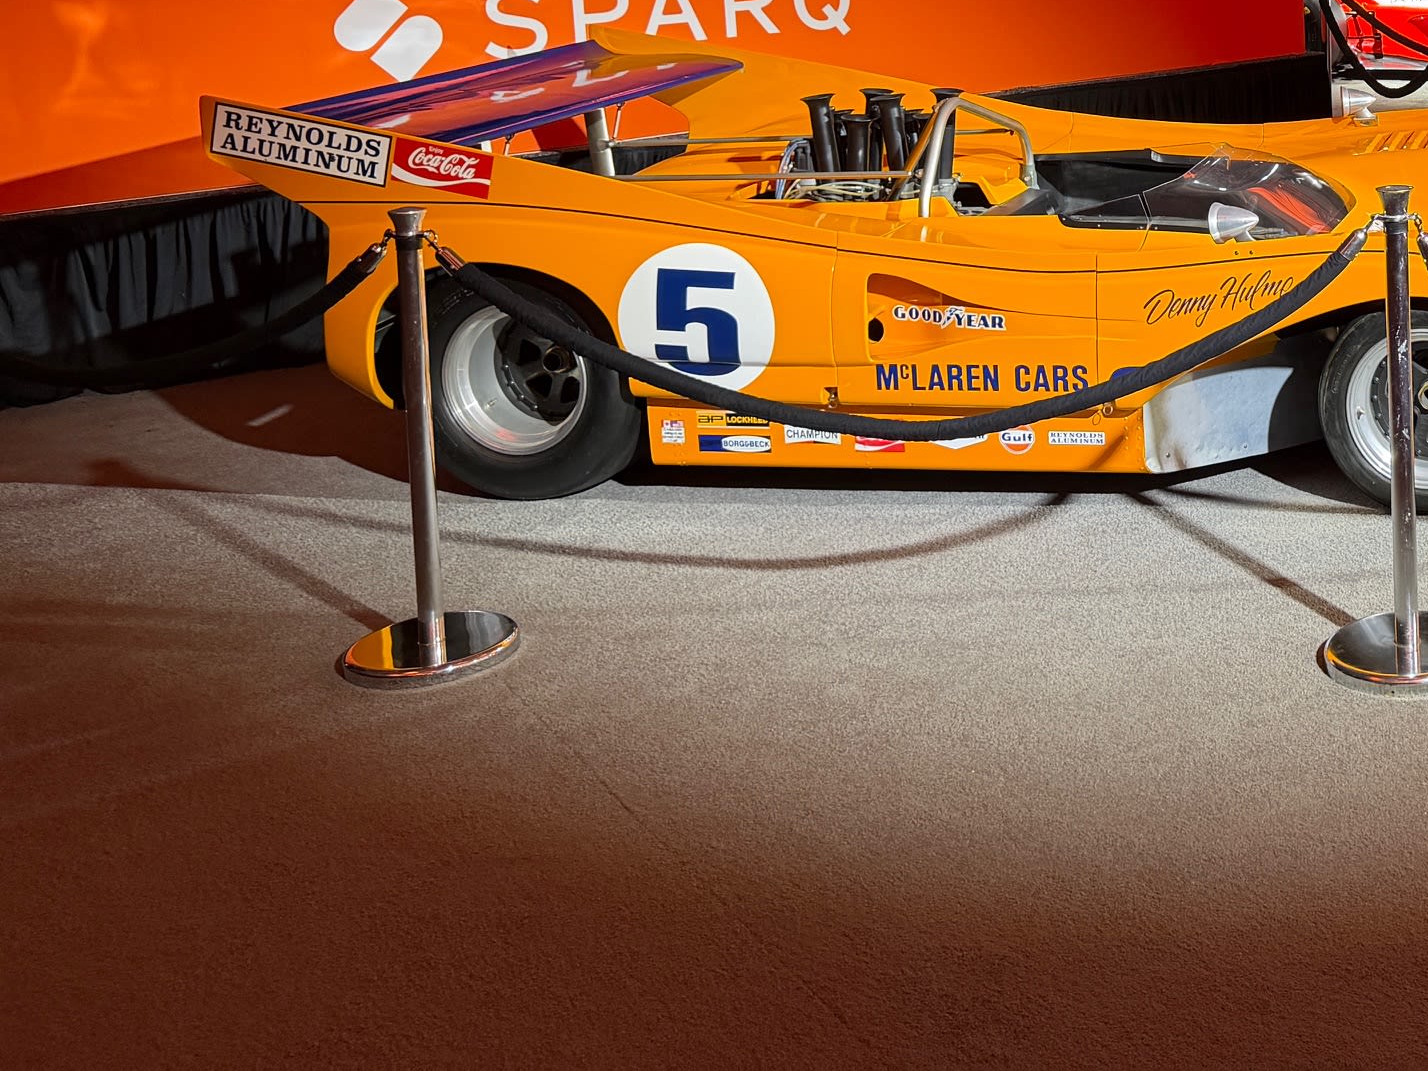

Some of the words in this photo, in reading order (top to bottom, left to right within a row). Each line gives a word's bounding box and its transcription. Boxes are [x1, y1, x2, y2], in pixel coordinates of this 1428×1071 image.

[222, 110, 382, 158] REYNOLDS
[220, 133, 379, 179] ALUMINUM
[408, 146, 480, 179] Coca-Cola
[1143, 288, 1218, 327] Denny
[1220, 270, 1294, 310] Hulme
[655, 267, 742, 376] 5
[892, 304, 1006, 331] GOODYEAR
[875, 363, 1000, 392] McLAREN
[1014, 364, 1089, 393] CARS
[723, 440, 770, 448] BORG&BECK
[786, 429, 839, 440] CHAMPION
[1001, 432, 1033, 442] Gulf
